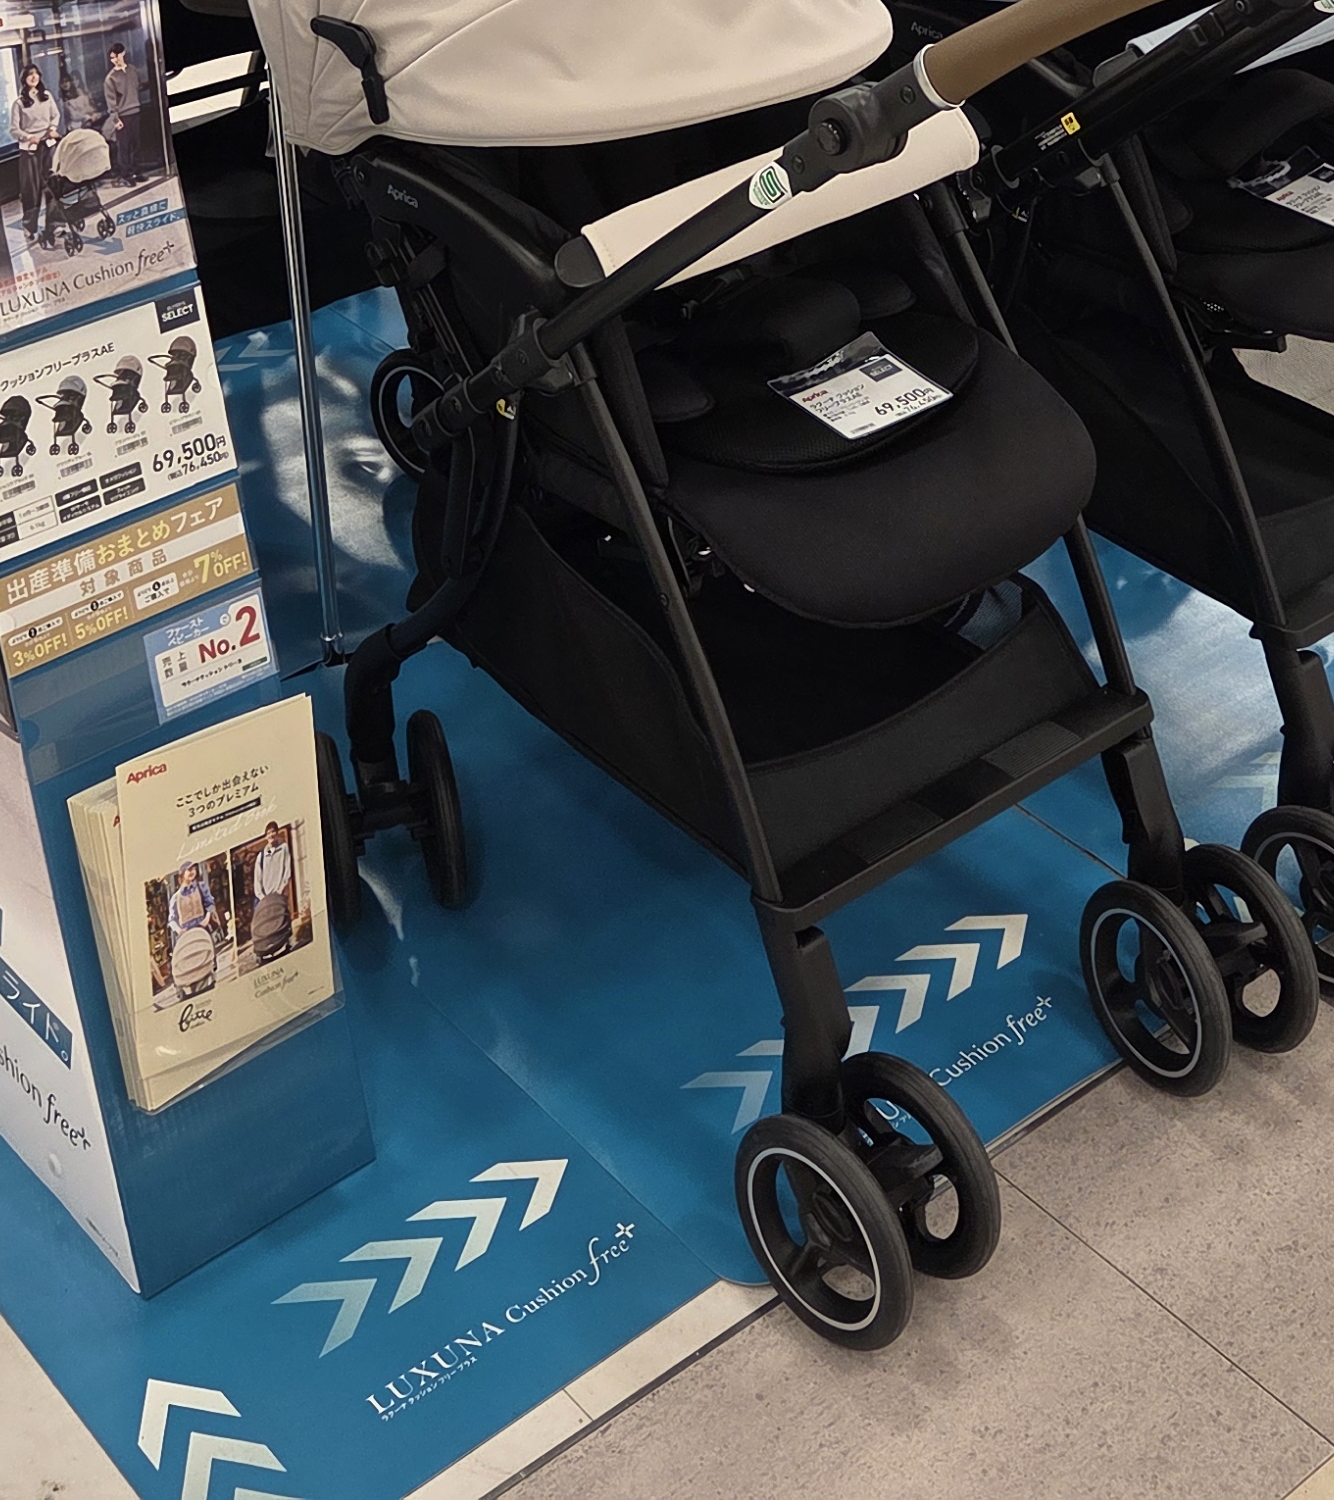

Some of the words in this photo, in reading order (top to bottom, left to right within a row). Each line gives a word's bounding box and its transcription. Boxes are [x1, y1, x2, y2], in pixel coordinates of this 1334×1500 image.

[0, 281, 71, 317] LUXUNA
[73, 260, 134, 290] Cushion
[161, 304, 194, 323] SELECT
[874, 387, 935, 416] 69,500円
[152, 432, 227, 473] 69,500円
[7, 497, 223, 604] 出産準備おまとめフェア
[75, 608, 130, 640] 5%OFF!
[198, 605, 261, 664] No.2
[12, 632, 68, 668] 3%OFF!
[126, 763, 167, 785] Aprica
[175, 764, 269, 808] ここでしか出会えない
[188, 783, 259, 818] 3つのプレミアム
[929, 1032, 1012, 1087] Cushion
[365, 1321, 506, 1415] LUXUNA
[505, 1268, 588, 1324] Cushion
